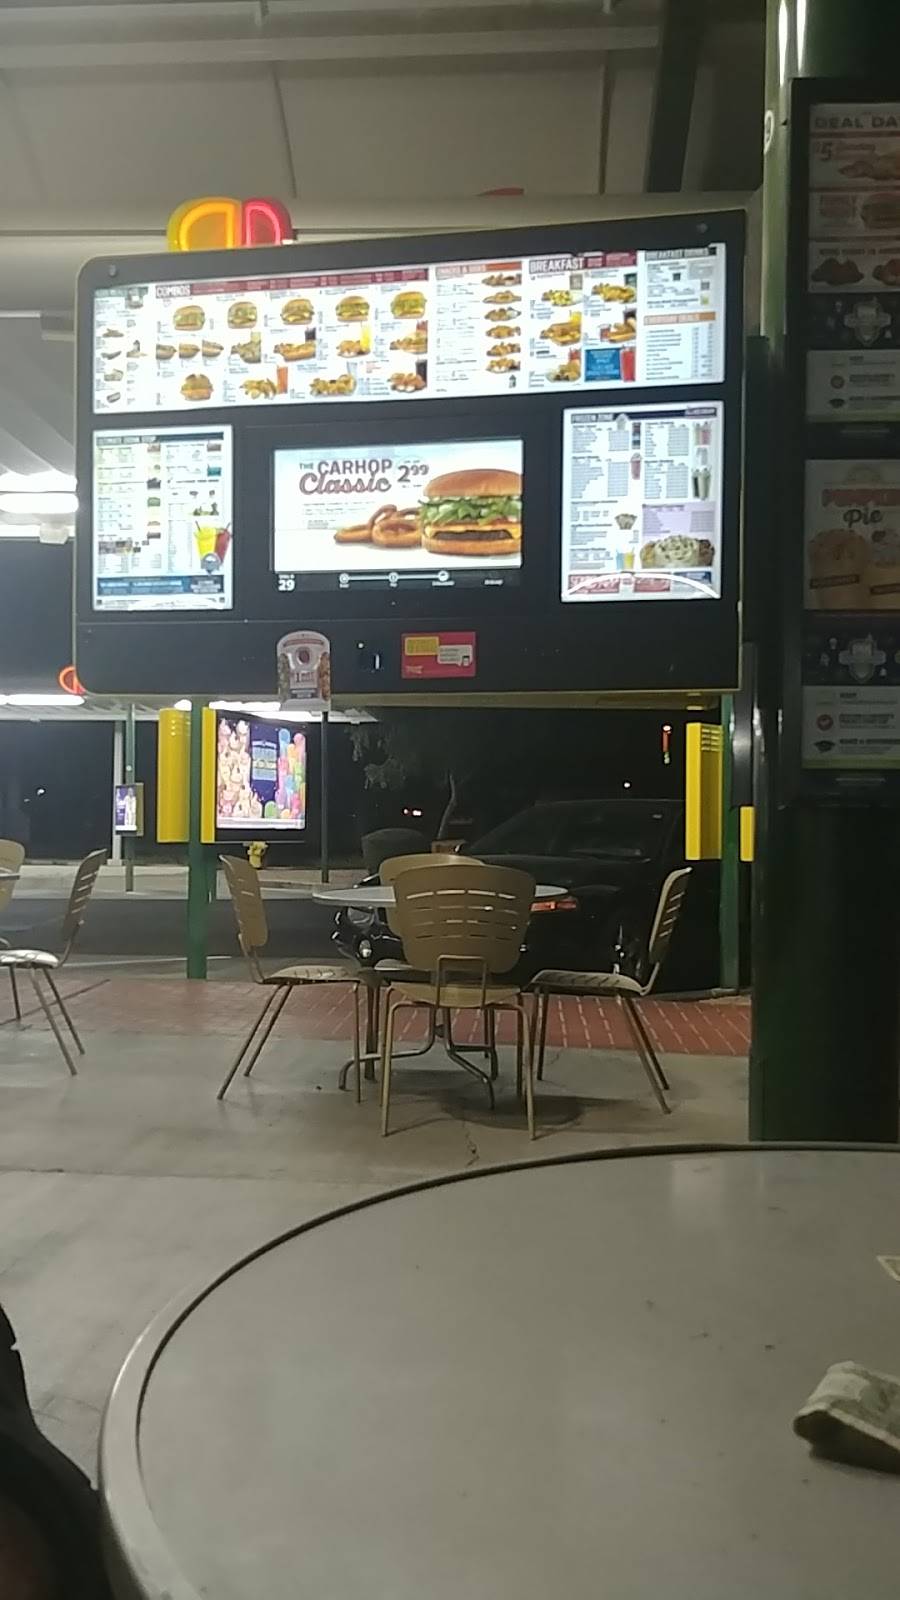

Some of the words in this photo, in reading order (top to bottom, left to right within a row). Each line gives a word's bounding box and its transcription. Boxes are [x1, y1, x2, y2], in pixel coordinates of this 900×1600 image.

[815, 116, 864, 128] DEAL
[871, 115, 900, 128] DA
[529, 257, 584, 274] BREAKFAST
[157, 284, 190, 298] COMBOS
[299, 462, 314, 470] THE
[317, 458, 392, 475] CARHOP
[299, 472, 392, 495] Classic
[843, 507, 882, 529] Pie
[278, 579, 296, 591] 29
